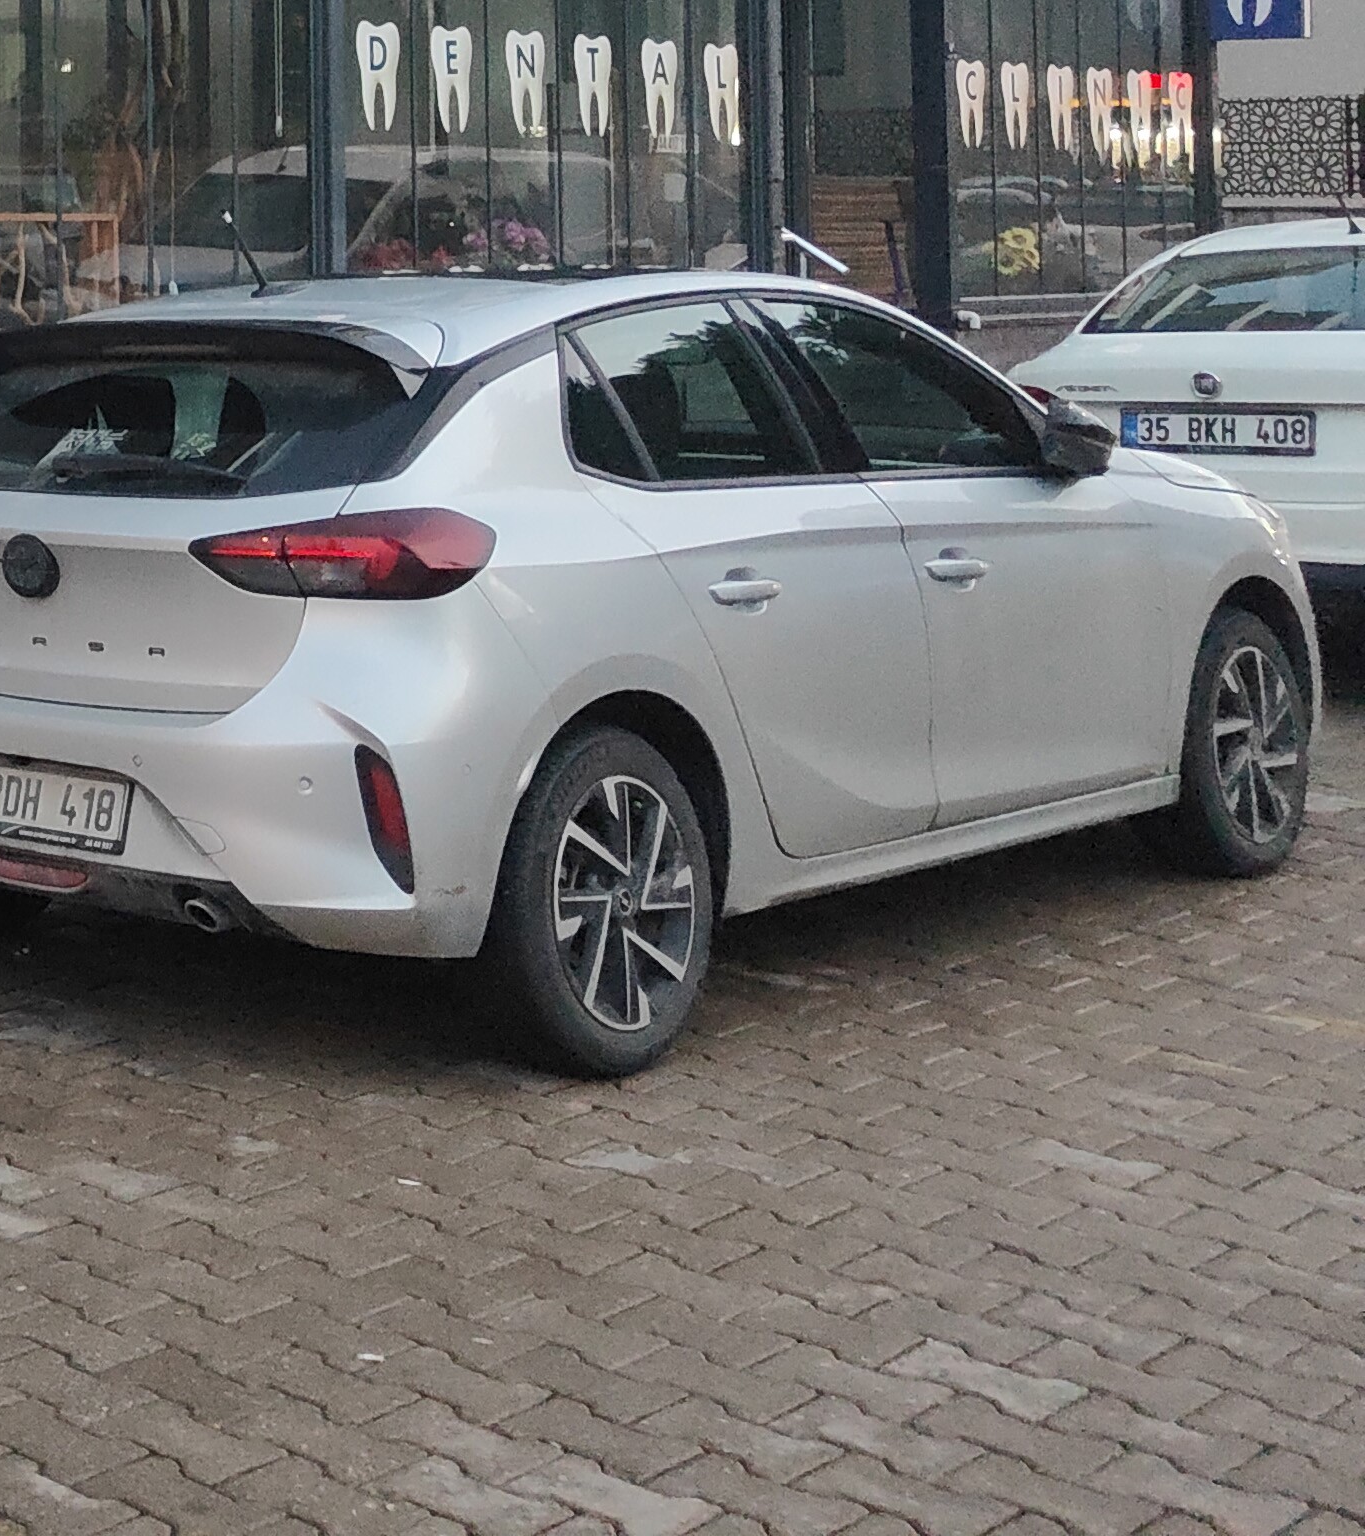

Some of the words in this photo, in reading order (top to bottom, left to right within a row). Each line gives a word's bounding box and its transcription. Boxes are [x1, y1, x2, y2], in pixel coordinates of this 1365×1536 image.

[1139, 417, 1170, 442] 35
[1188, 418, 1236, 444] BKH
[1256, 418, 1307, 444] 408
[60, 783, 116, 832] 418
